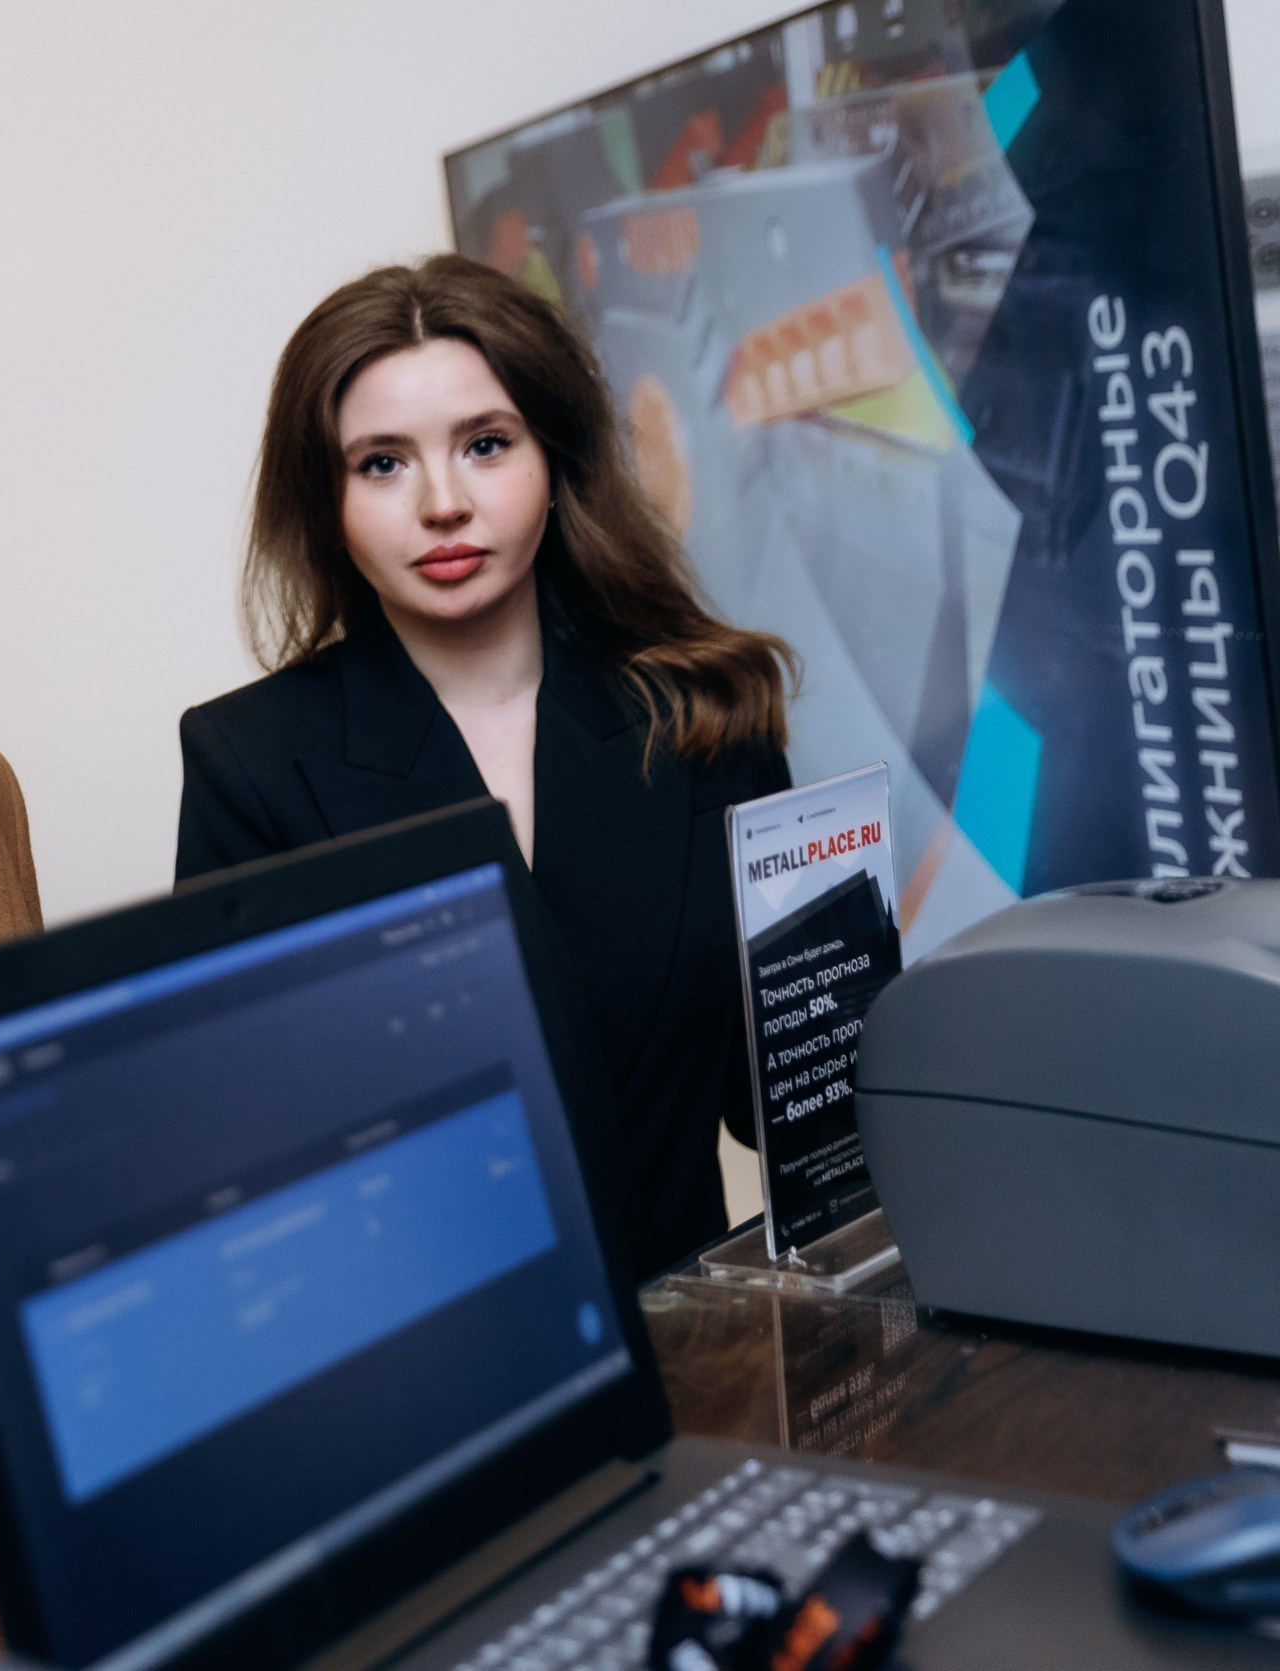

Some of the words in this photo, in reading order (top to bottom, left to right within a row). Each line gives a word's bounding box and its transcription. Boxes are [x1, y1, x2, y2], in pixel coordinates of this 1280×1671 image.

[1140, 325, 1210, 520] Q43
[1087, 294, 1191, 878] лигаторные
[748, 820, 882, 884] METALLPLACE.RU
[760, 977, 815, 1007] Точность
[816, 953, 870, 987] прогноза
[787, 952, 804, 967] Сочи
[764, 1007, 808, 1037] погоды
[809, 993, 838, 1018] 50%.
[767, 1052, 777, 1071] А
[778, 1034, 831, 1066] точность
[770, 1077, 793, 1100] цен
[795, 1070, 810, 1088] на
[811, 1053, 848, 1080] сырье
[786, 1093, 824, 1122] более
[825, 1078, 853, 1104] 93%.
[821, 1154, 865, 1182] METALLPLACE
